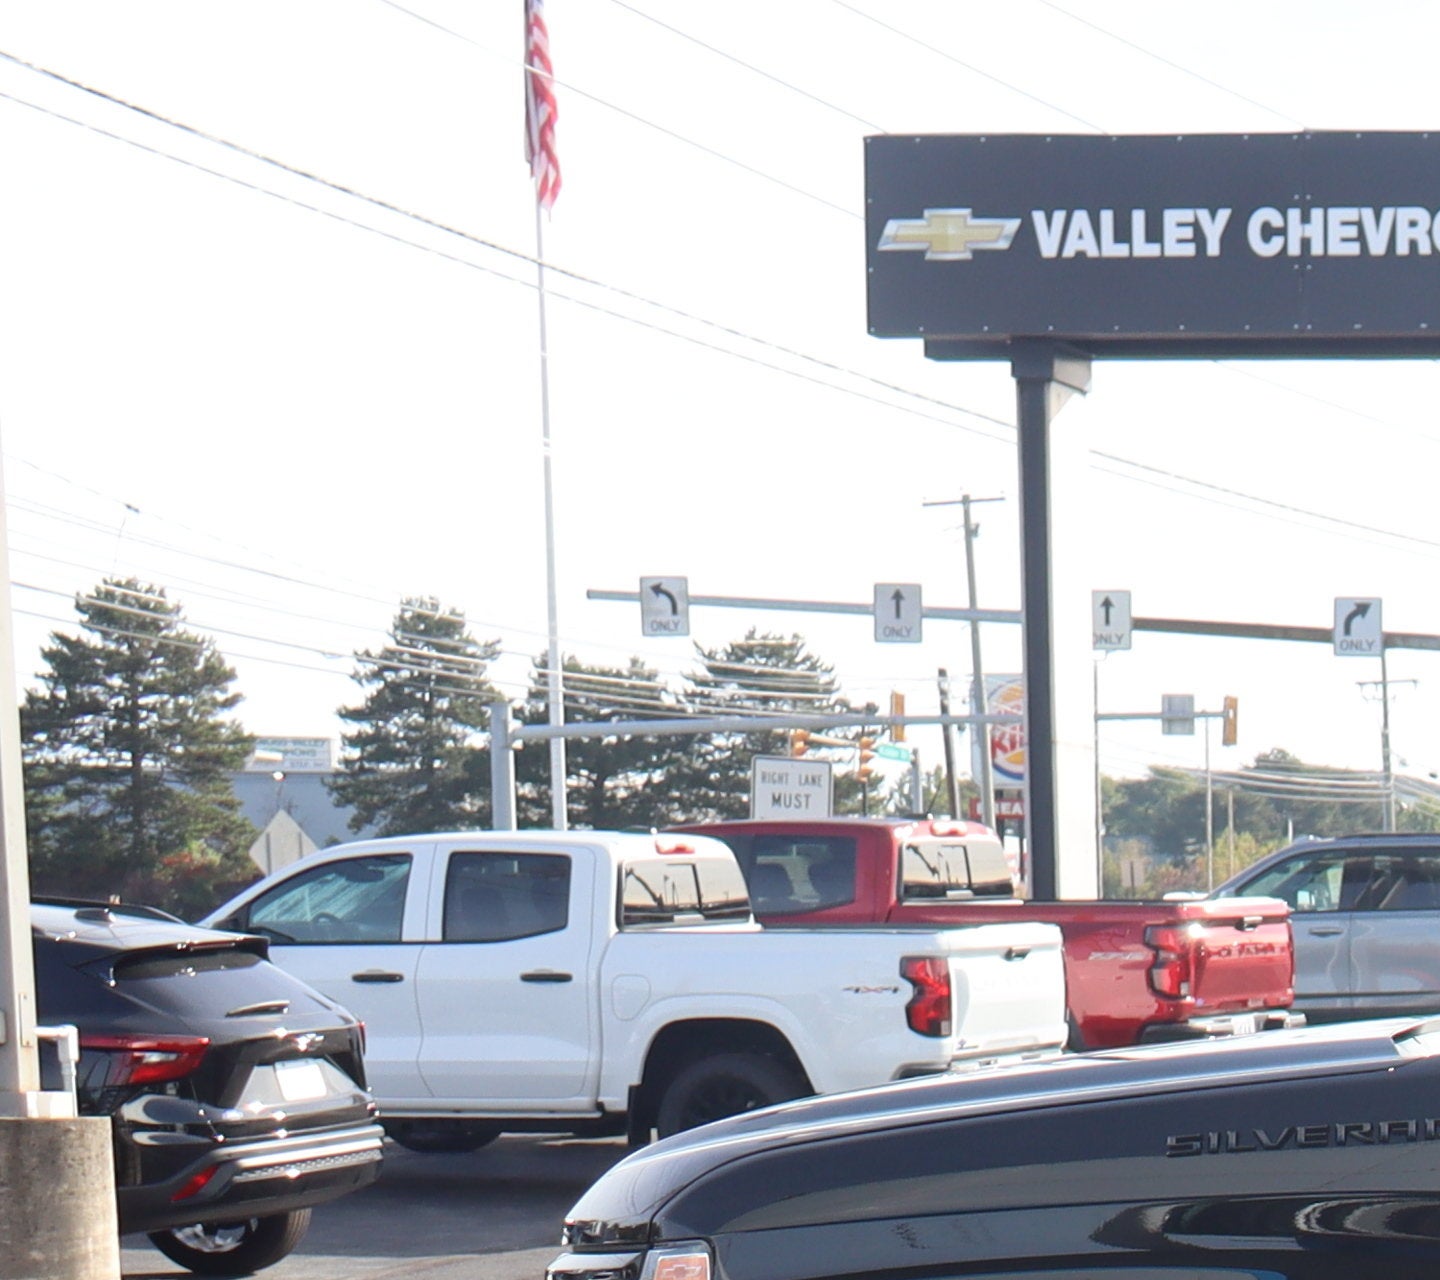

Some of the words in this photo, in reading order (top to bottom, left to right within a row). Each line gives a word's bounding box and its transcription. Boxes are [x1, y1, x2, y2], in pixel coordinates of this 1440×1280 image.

[1032, 207, 1232, 258] VALLEY
[650, 620, 681, 632] ONLY
[883, 626, 913, 638] ONLY
[1339, 639, 1376, 651] ONLY
[761, 771, 789, 784] RIGHT
[798, 773, 822, 787] LANE
[771, 792, 812, 809] MUST
